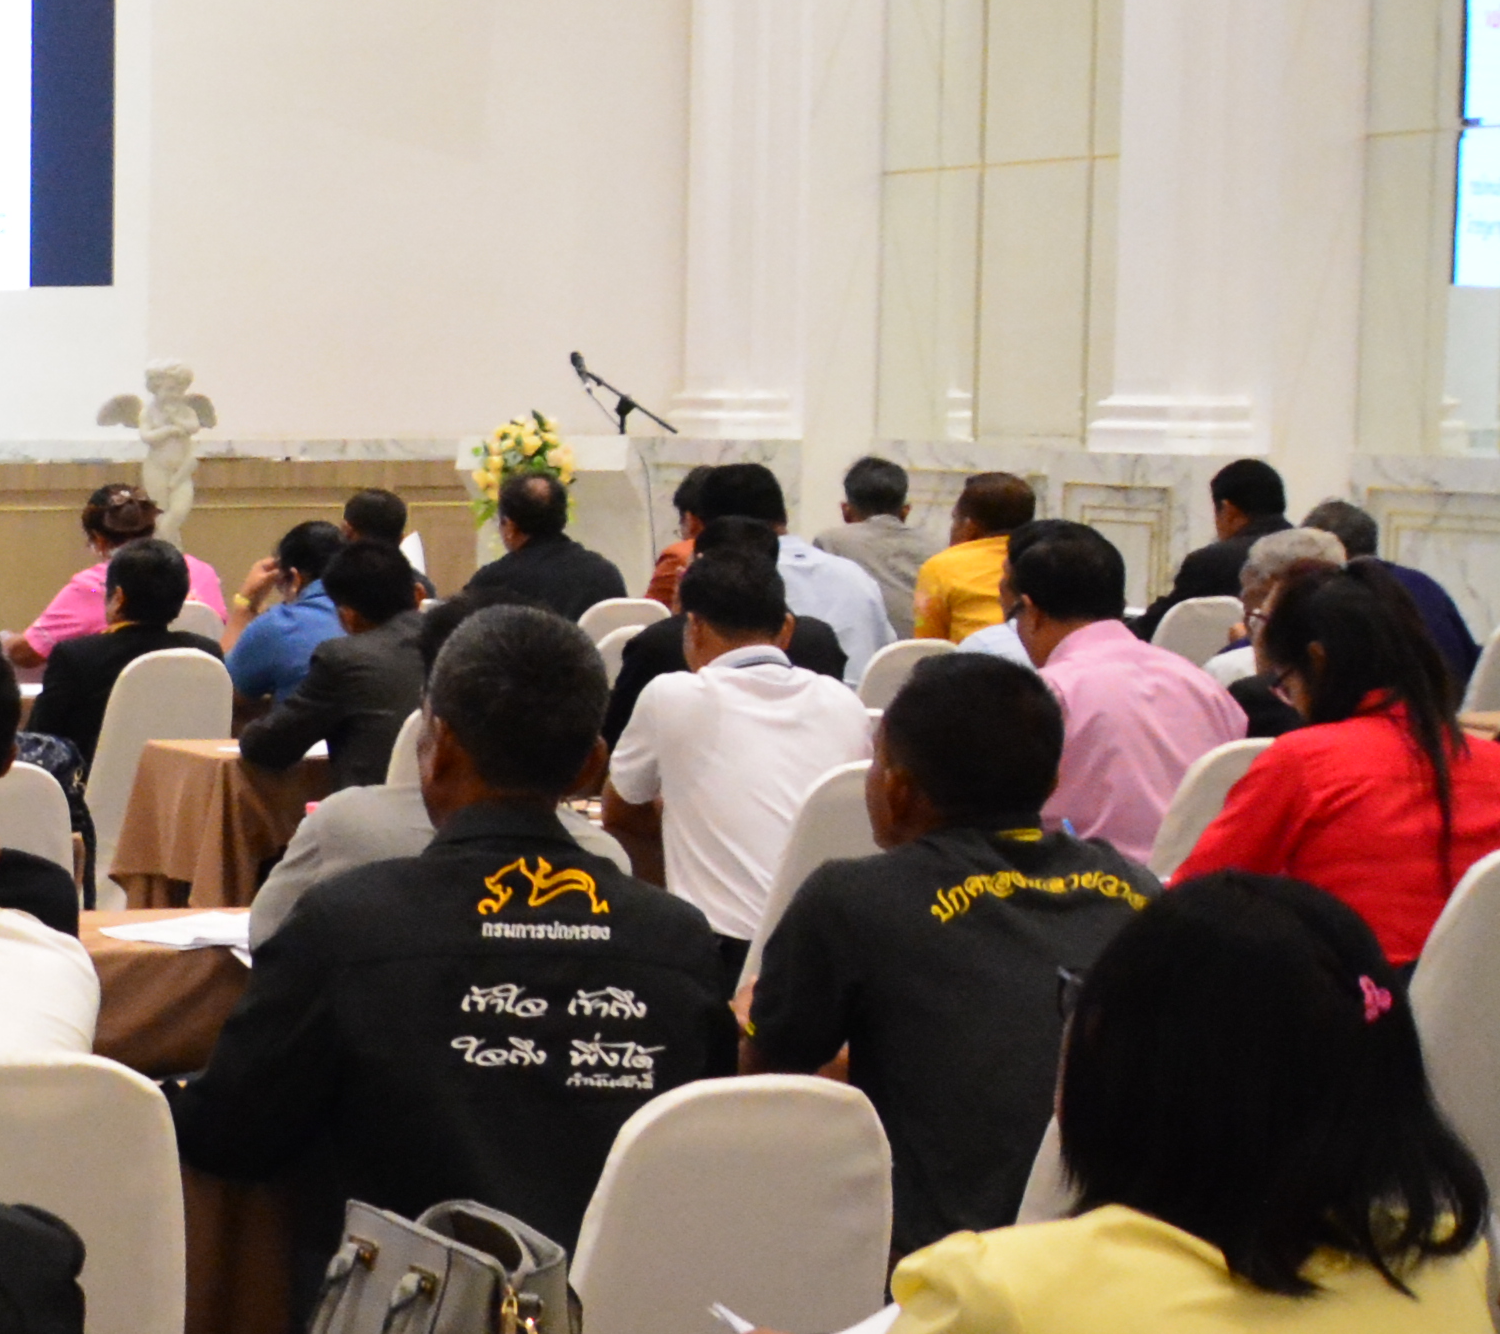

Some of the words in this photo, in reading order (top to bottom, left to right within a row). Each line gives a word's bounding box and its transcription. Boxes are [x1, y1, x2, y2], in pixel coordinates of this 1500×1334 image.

[481, 921, 611, 941] กรมการปกครอง
[461, 983, 549, 1018] เข้าใจ
[567, 985, 648, 1020] เข้าถึง
